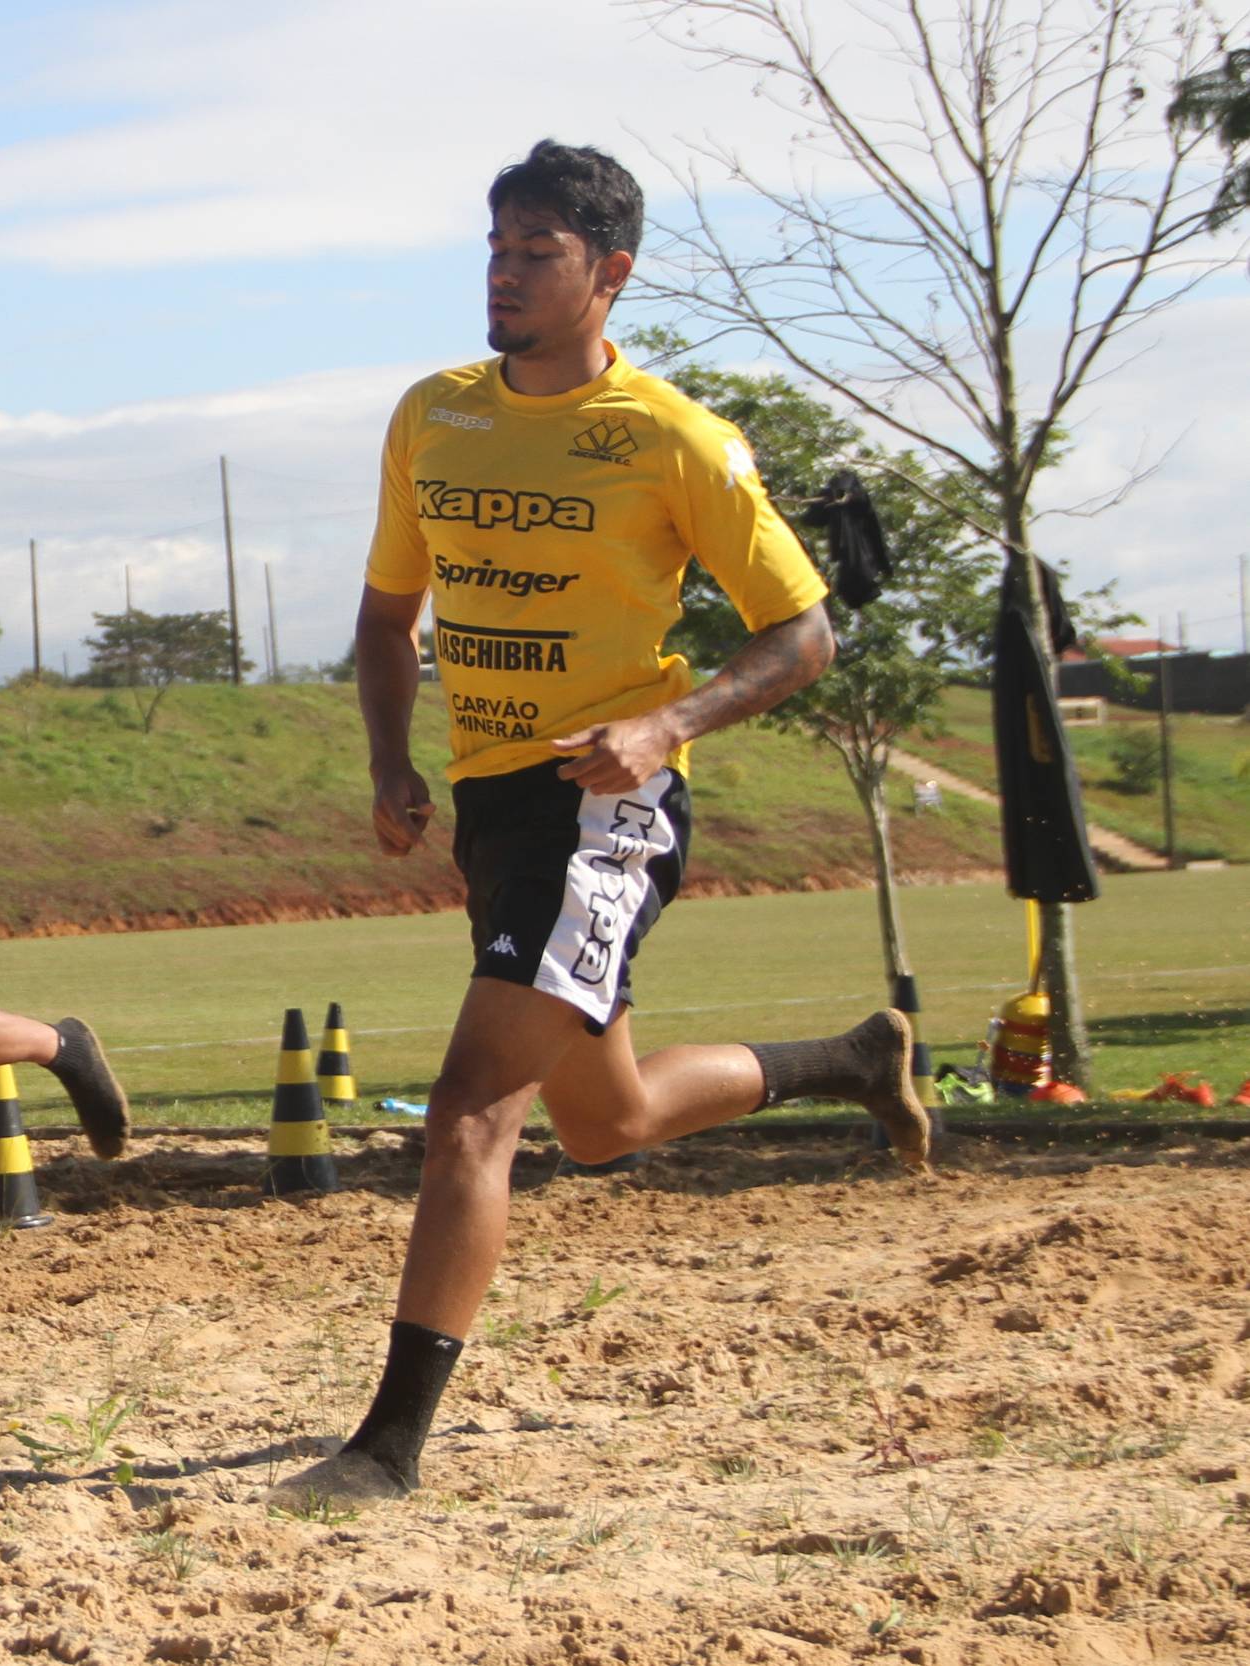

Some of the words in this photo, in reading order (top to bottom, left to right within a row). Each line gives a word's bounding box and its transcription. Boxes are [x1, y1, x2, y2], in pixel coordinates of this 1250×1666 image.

[415, 480, 594, 532] Kappa
[435, 554, 580, 597] Springer
[435, 617, 568, 672] TASCHIBRA
[452, 693, 538, 720] CARVÃO
